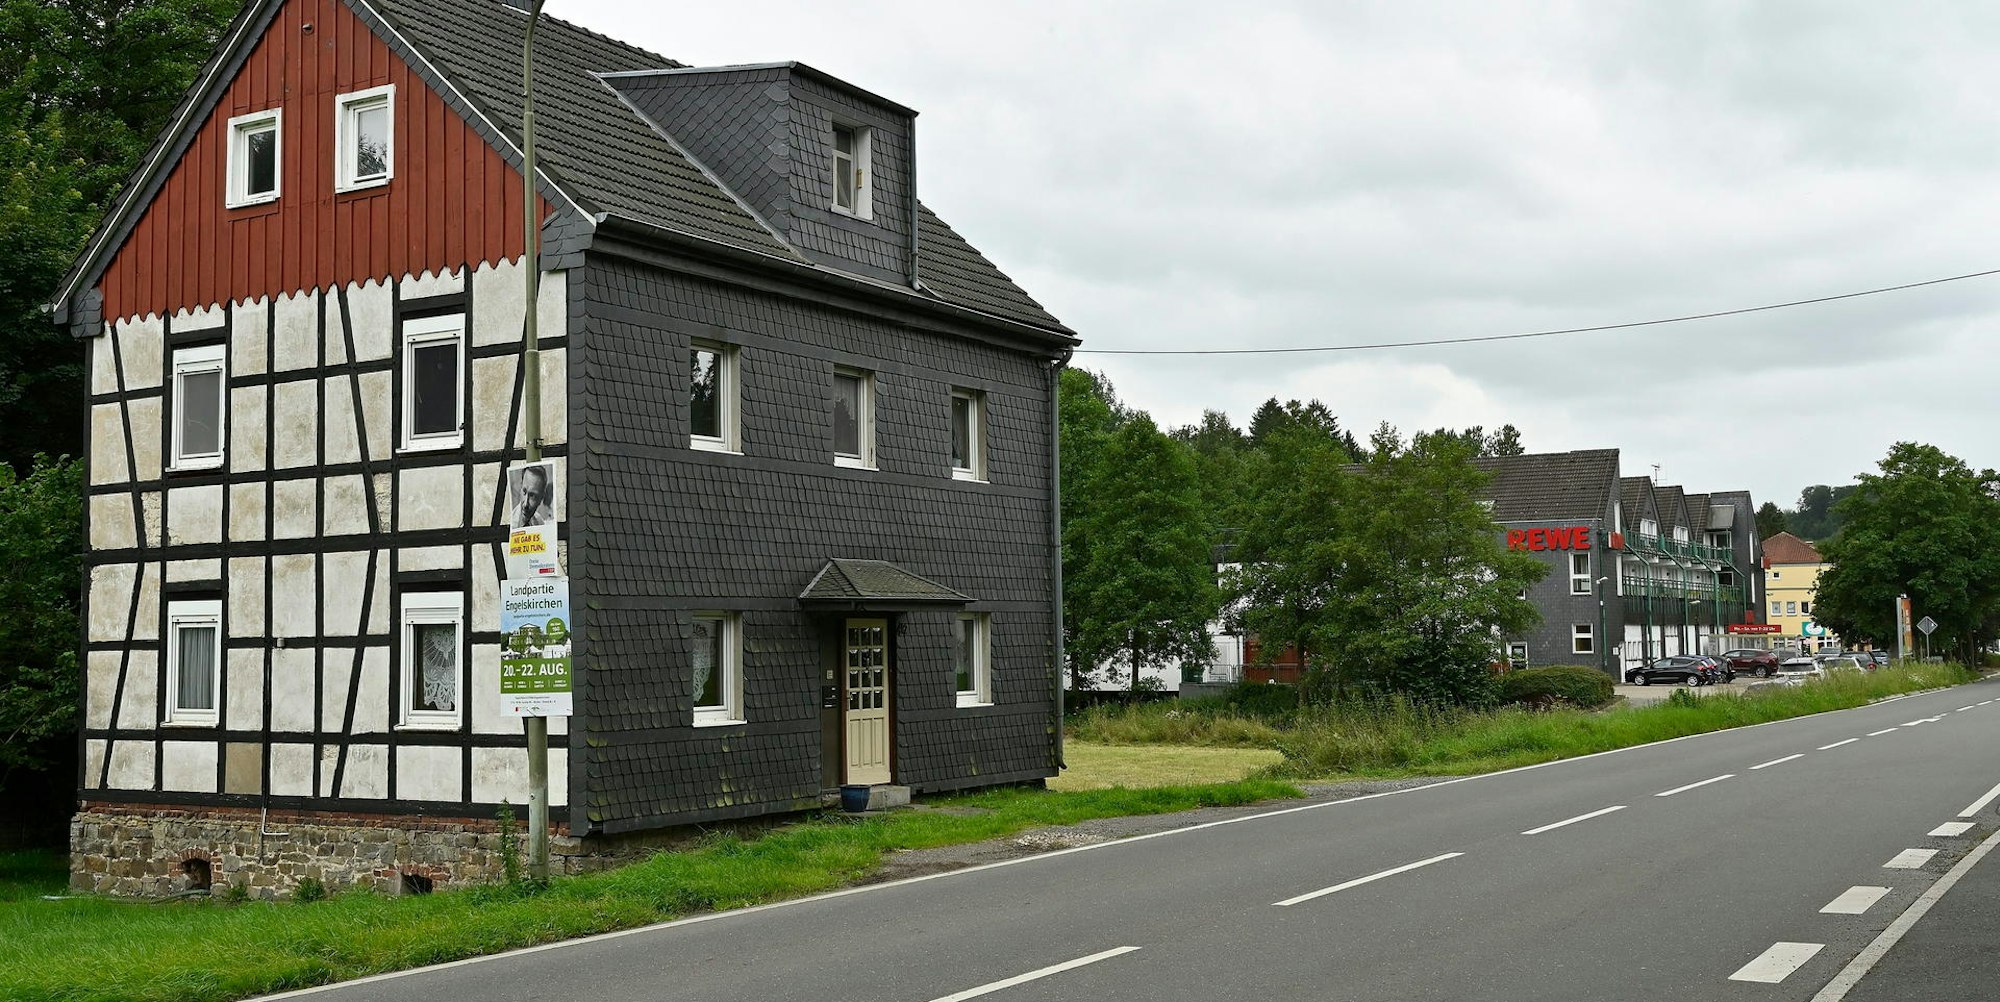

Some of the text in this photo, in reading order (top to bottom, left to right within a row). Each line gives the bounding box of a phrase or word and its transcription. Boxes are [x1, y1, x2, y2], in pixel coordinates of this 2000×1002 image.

[533, 534, 540, 542] ES
[1507, 527, 1591, 551] REWE
[510, 583, 554, 597] Landpartie
[505, 598, 563, 613] Engelskirchen
[539, 663, 568, 676] AUG.
